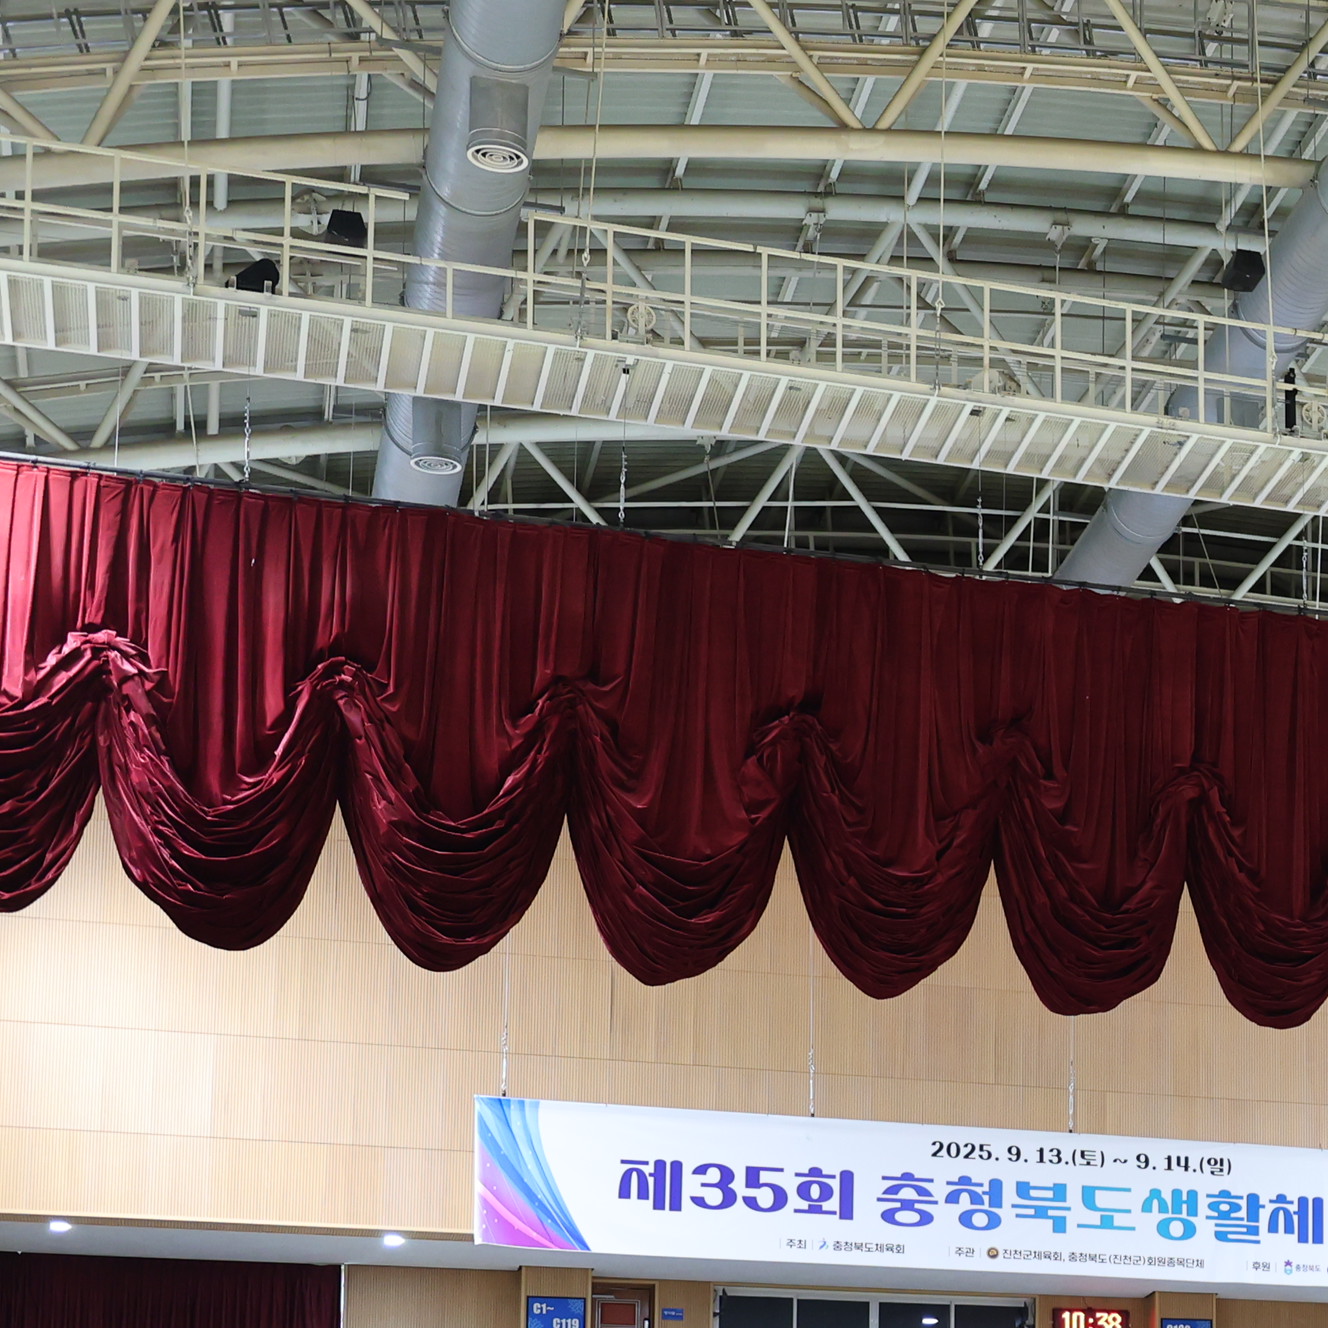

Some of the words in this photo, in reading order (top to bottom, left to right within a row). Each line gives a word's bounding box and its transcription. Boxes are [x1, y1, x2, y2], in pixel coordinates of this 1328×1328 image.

[930, 1140, 1000, 1162] 2025.
[618, 1158, 855, 1221] 제35회
[786, 1238, 807, 1250] 주최
[832, 1240, 906, 1255] 충청북도체육회
[954, 1246, 976, 1259] 주관
[1252, 1260, 1271, 1272] 후원
